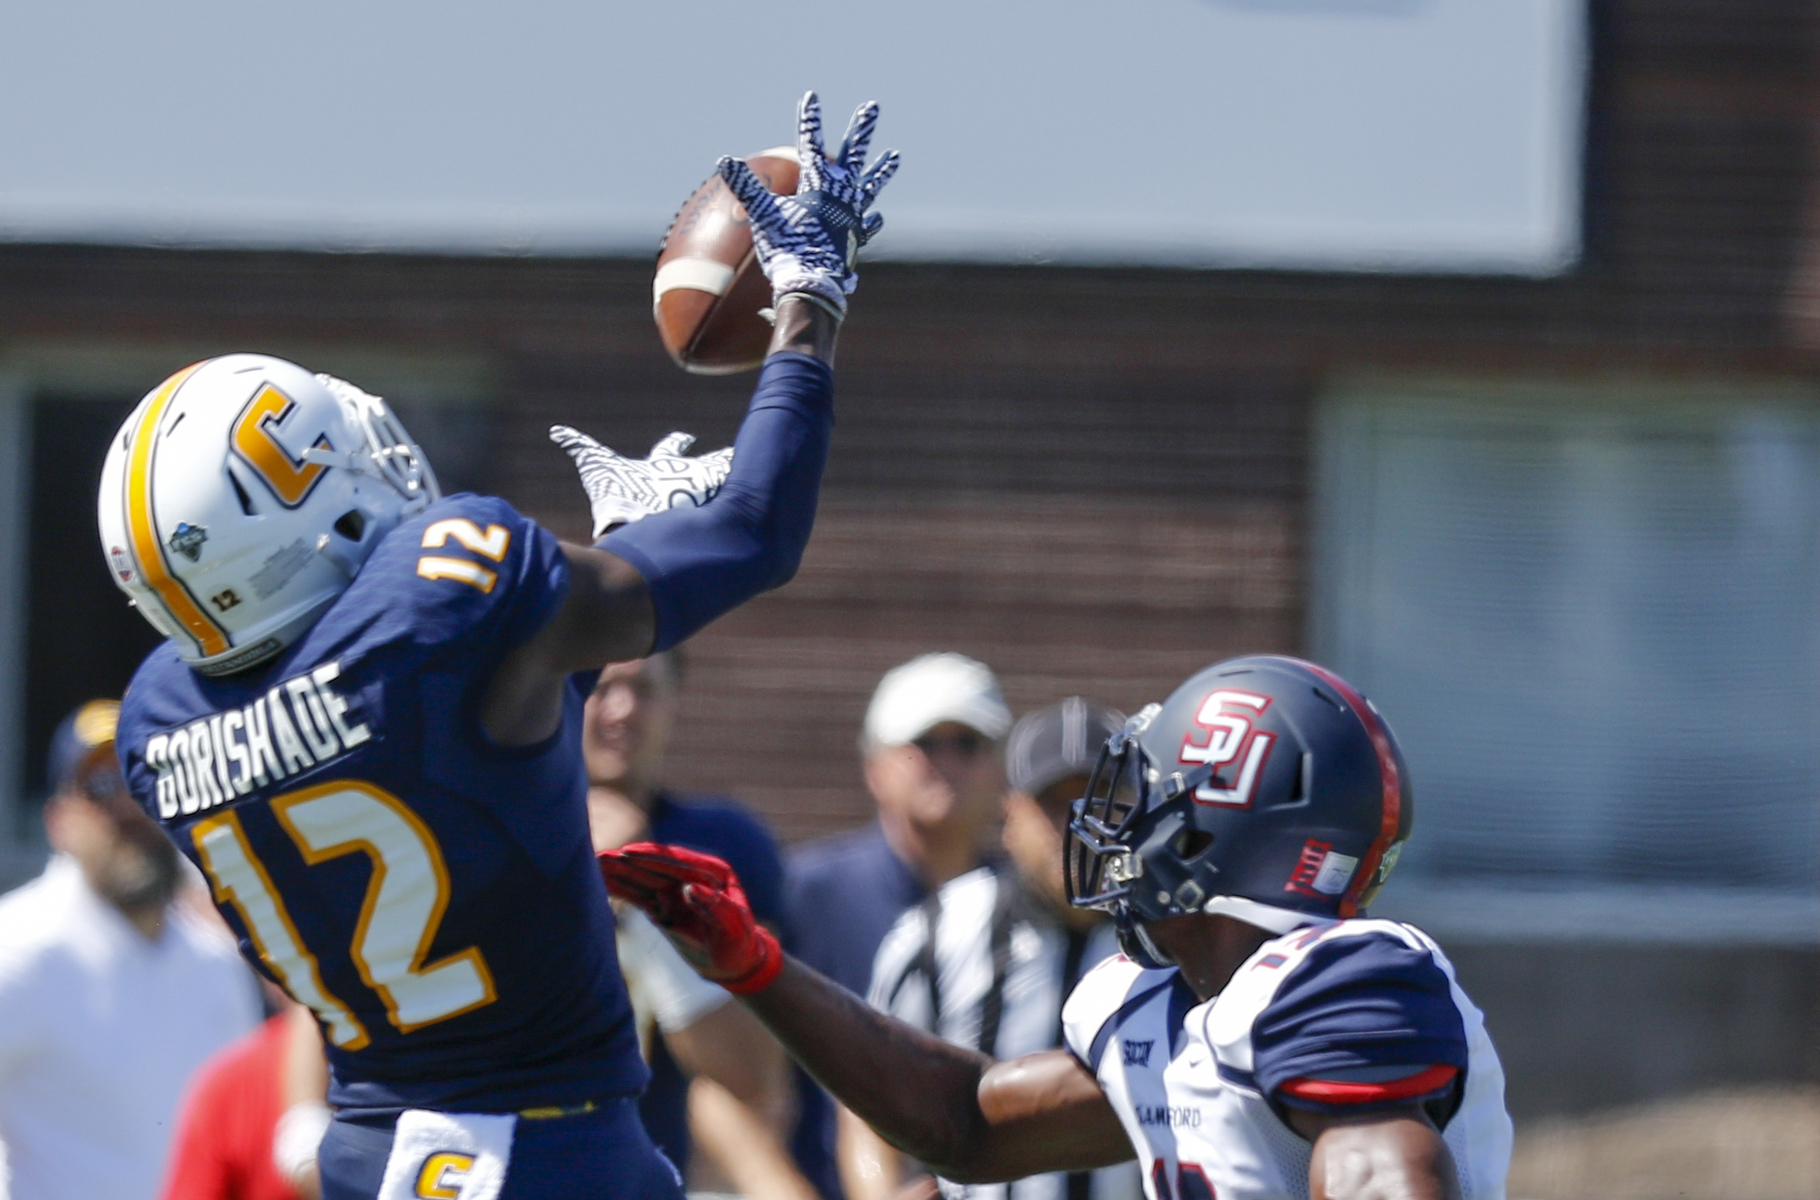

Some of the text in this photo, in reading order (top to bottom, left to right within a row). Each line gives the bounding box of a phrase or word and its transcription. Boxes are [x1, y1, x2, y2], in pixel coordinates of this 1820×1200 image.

[229, 380, 335, 510] C
[211, 588, 243, 612] 12
[417, 517, 510, 594] 12
[146, 662, 371, 819] BORISHADE
[1178, 687, 1278, 809] SU
[190, 778, 498, 1051] 12
